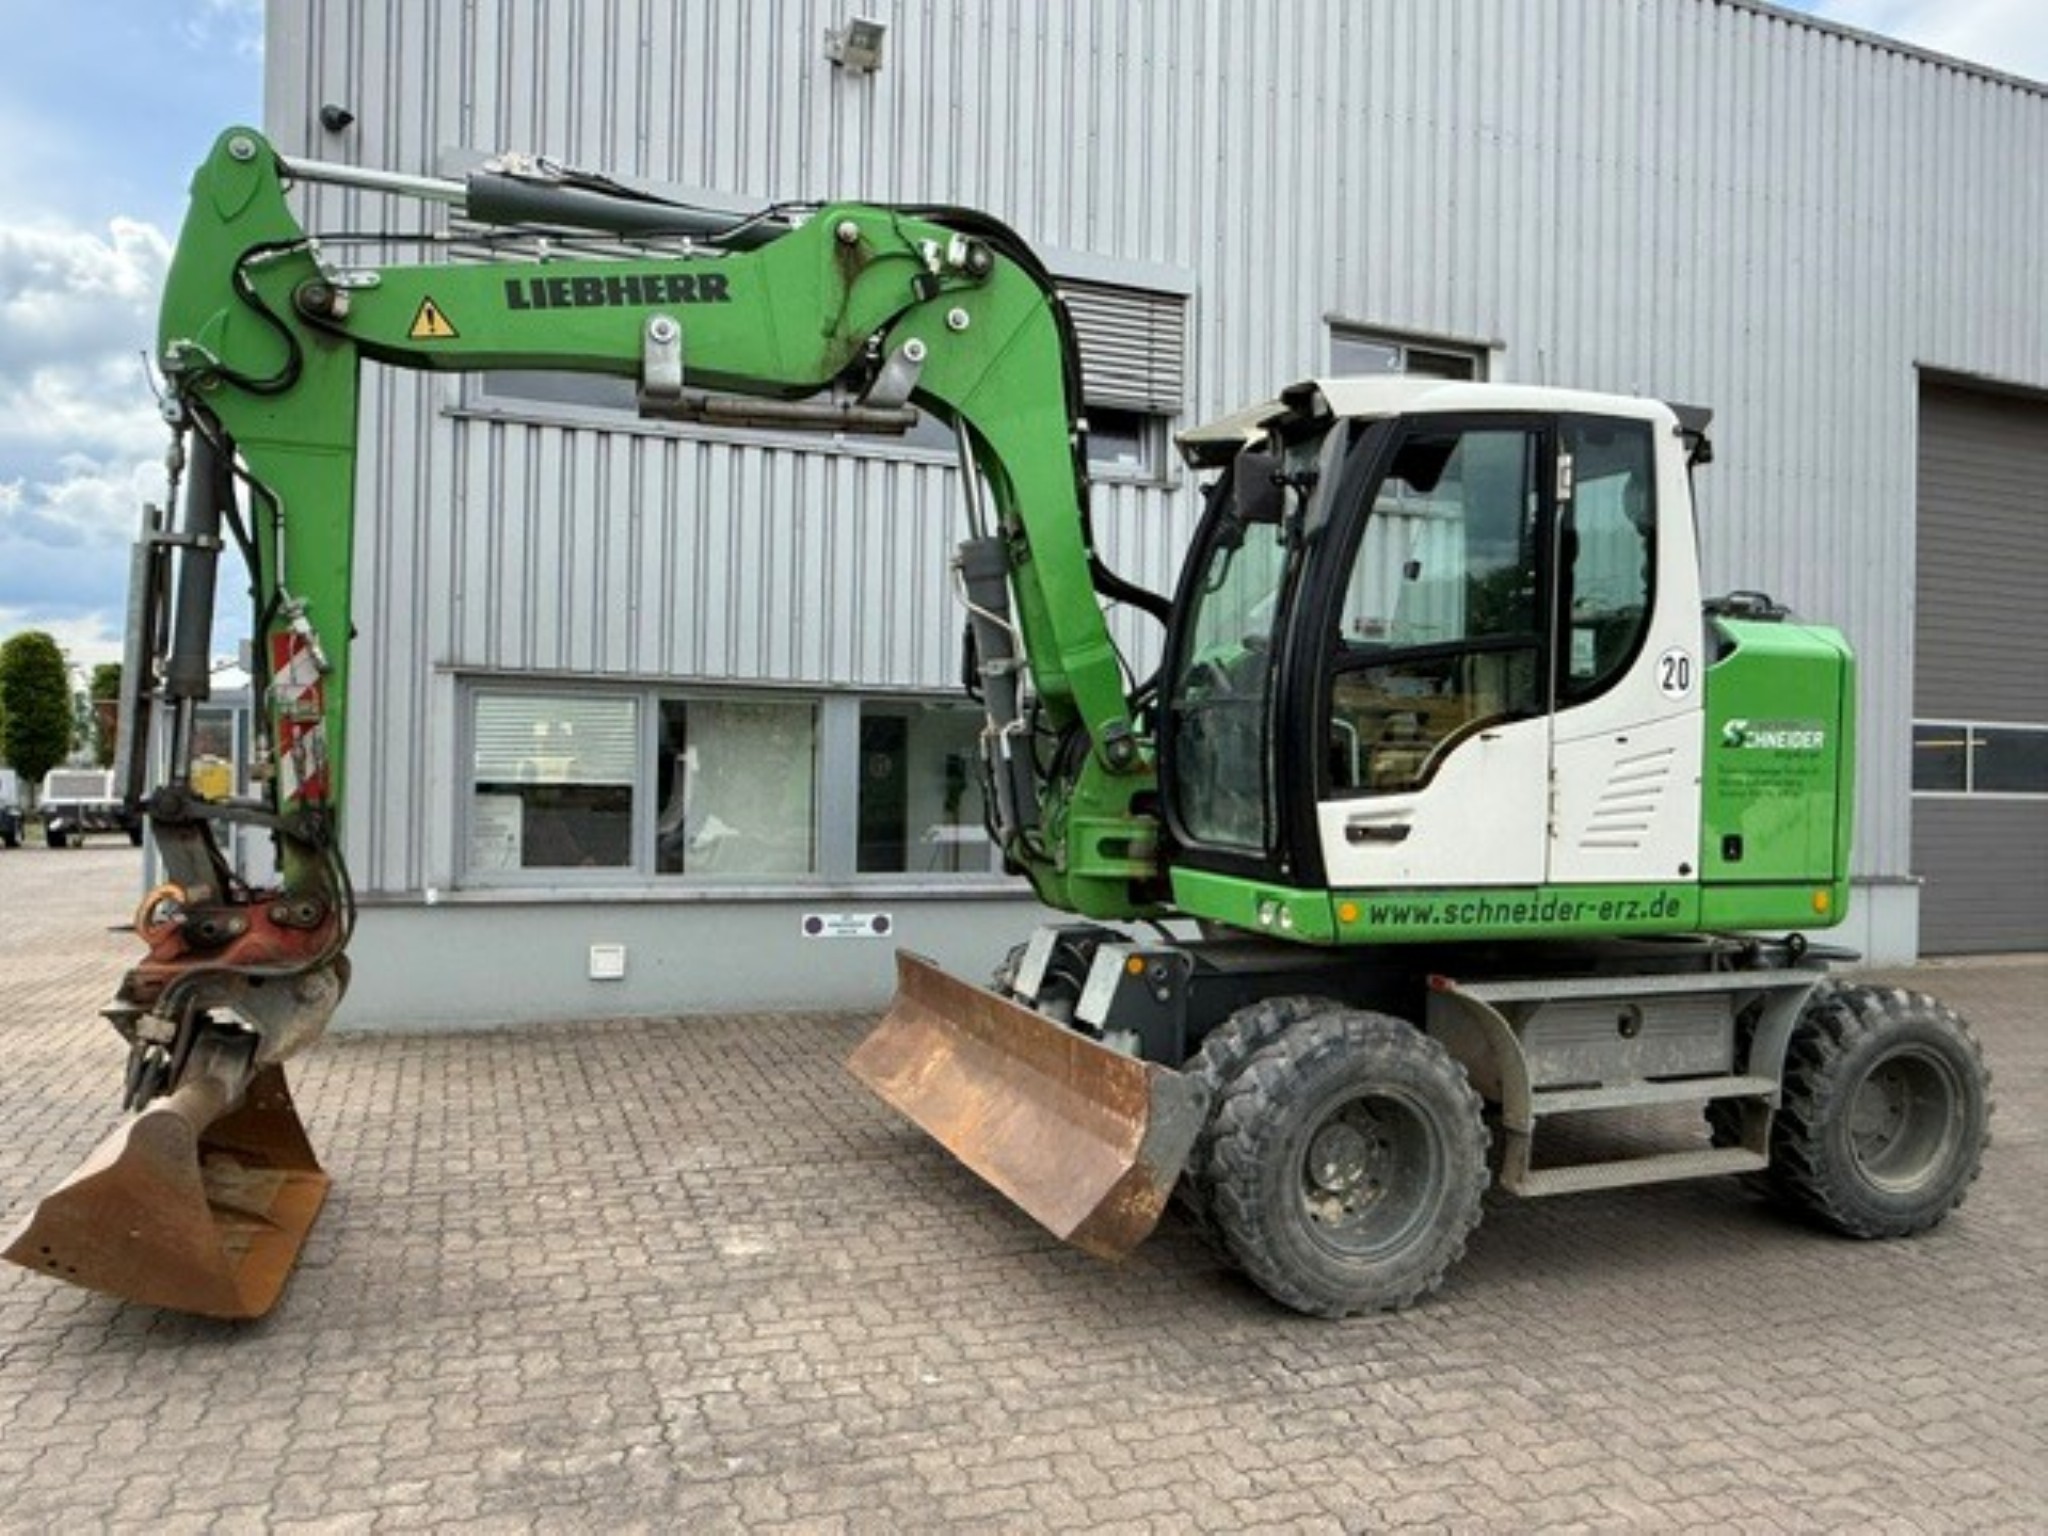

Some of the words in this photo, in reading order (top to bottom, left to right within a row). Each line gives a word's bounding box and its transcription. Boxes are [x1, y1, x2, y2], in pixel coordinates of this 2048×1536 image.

[504, 273, 731, 310] LIEBHERR
[1662, 656, 1690, 690] 20
[1721, 718, 1825, 749] SCHNEIDER
[1370, 891, 1681, 926] www.schneider-erz.de
